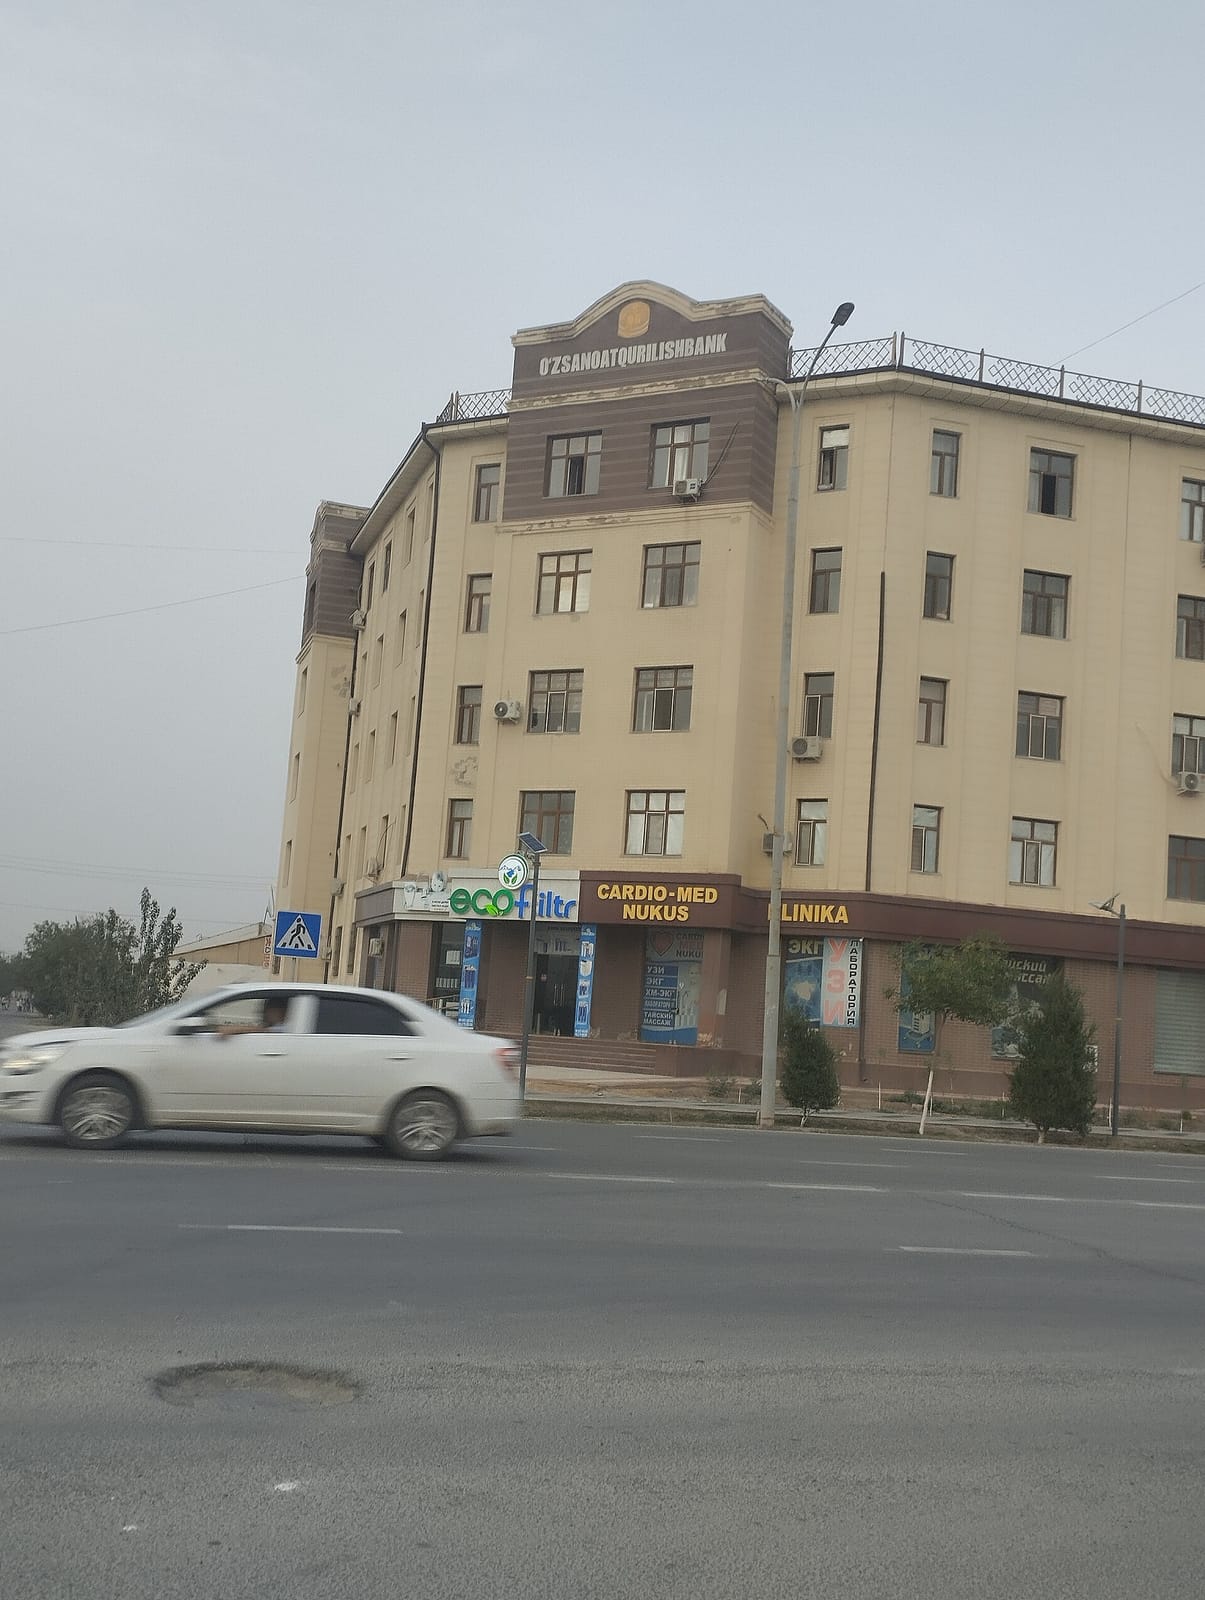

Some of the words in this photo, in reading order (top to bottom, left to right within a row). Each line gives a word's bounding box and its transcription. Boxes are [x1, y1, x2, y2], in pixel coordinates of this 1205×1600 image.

[597, 884, 718, 904] CARDIO-MED
[622, 904, 689, 921] NUKUS
[788, 939, 823, 955] ЭКГ
[647, 966, 665, 975] УЗИ
[646, 977, 665, 986] ЭКГ
[823, 938, 849, 1025] УЗИ
[846, 940, 860, 1025] ЛАБОРАТОРИЯ
